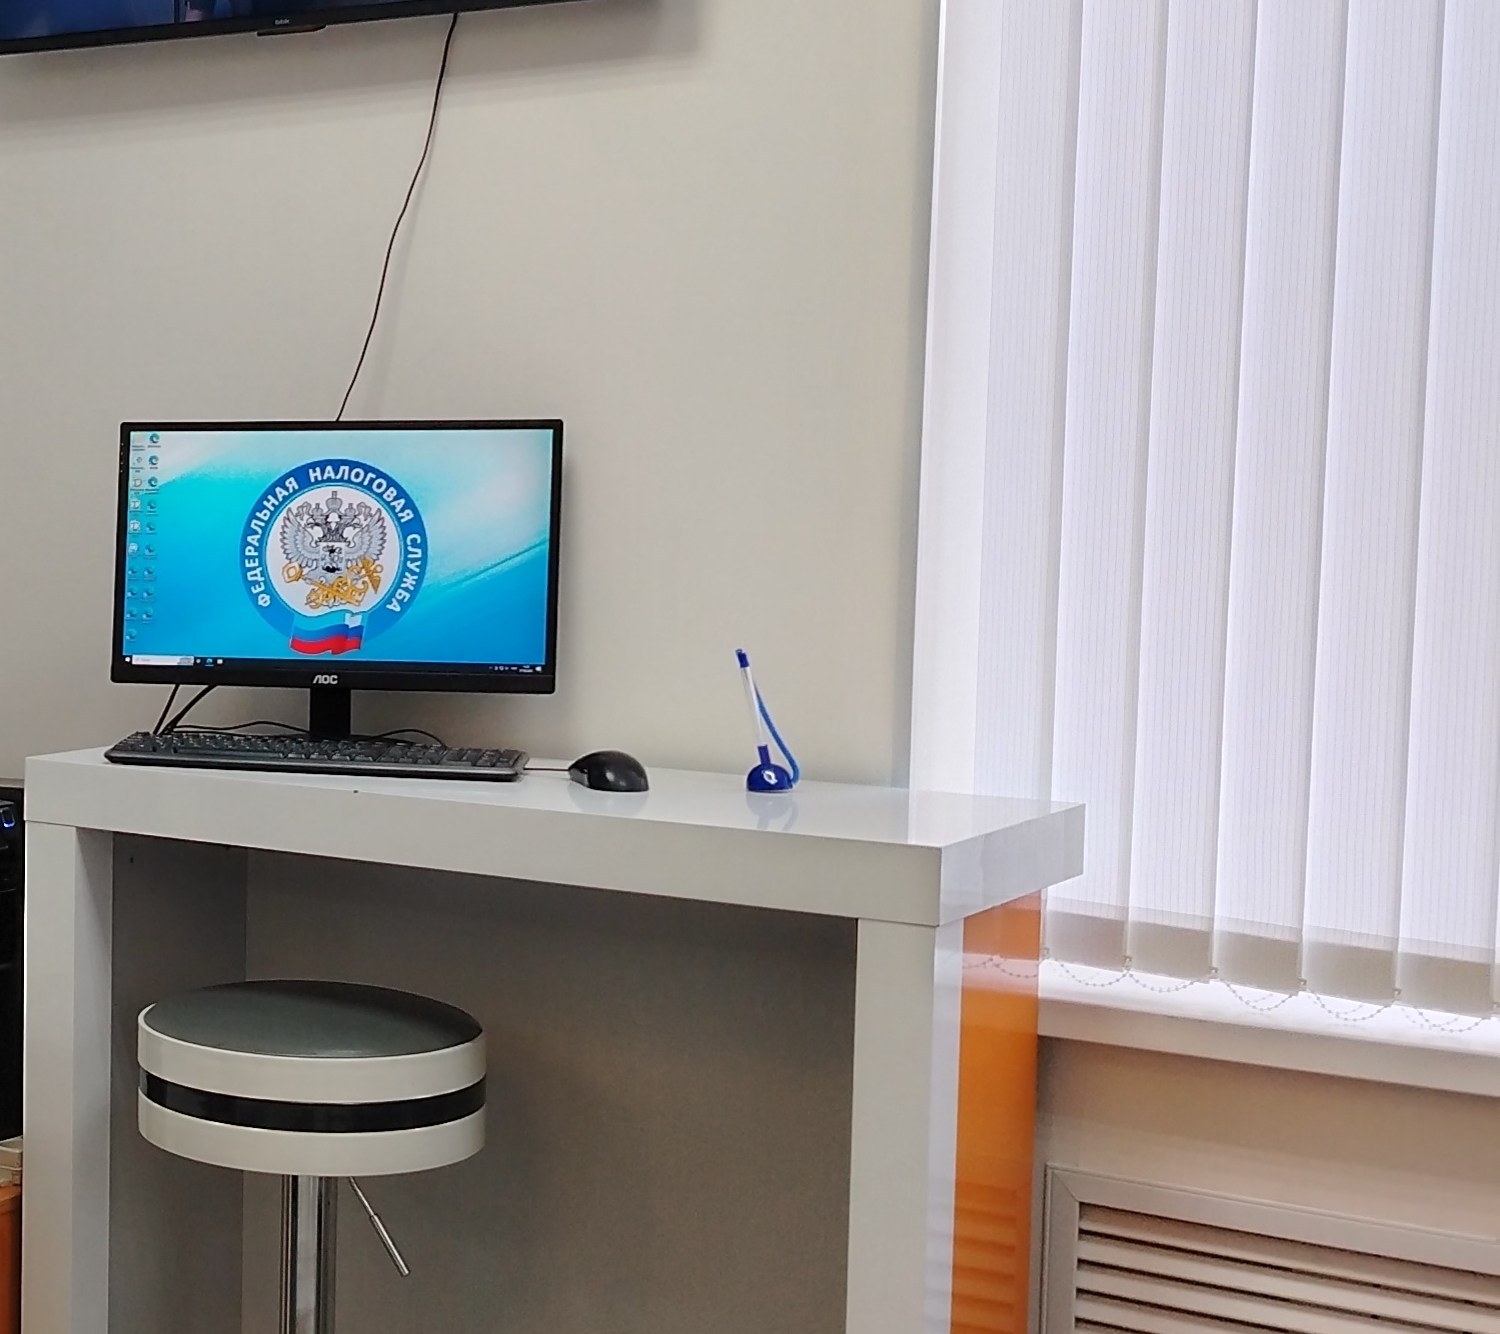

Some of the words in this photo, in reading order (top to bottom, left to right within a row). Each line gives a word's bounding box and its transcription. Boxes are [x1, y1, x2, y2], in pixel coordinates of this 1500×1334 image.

[244, 476, 299, 609] ФЕДЕРАЛЬНАЯ
[308, 465, 414, 525] НАЛОГОВАЯ
[386, 533, 422, 614] СЛУЖБА
[312, 674, 338, 685] AOC
